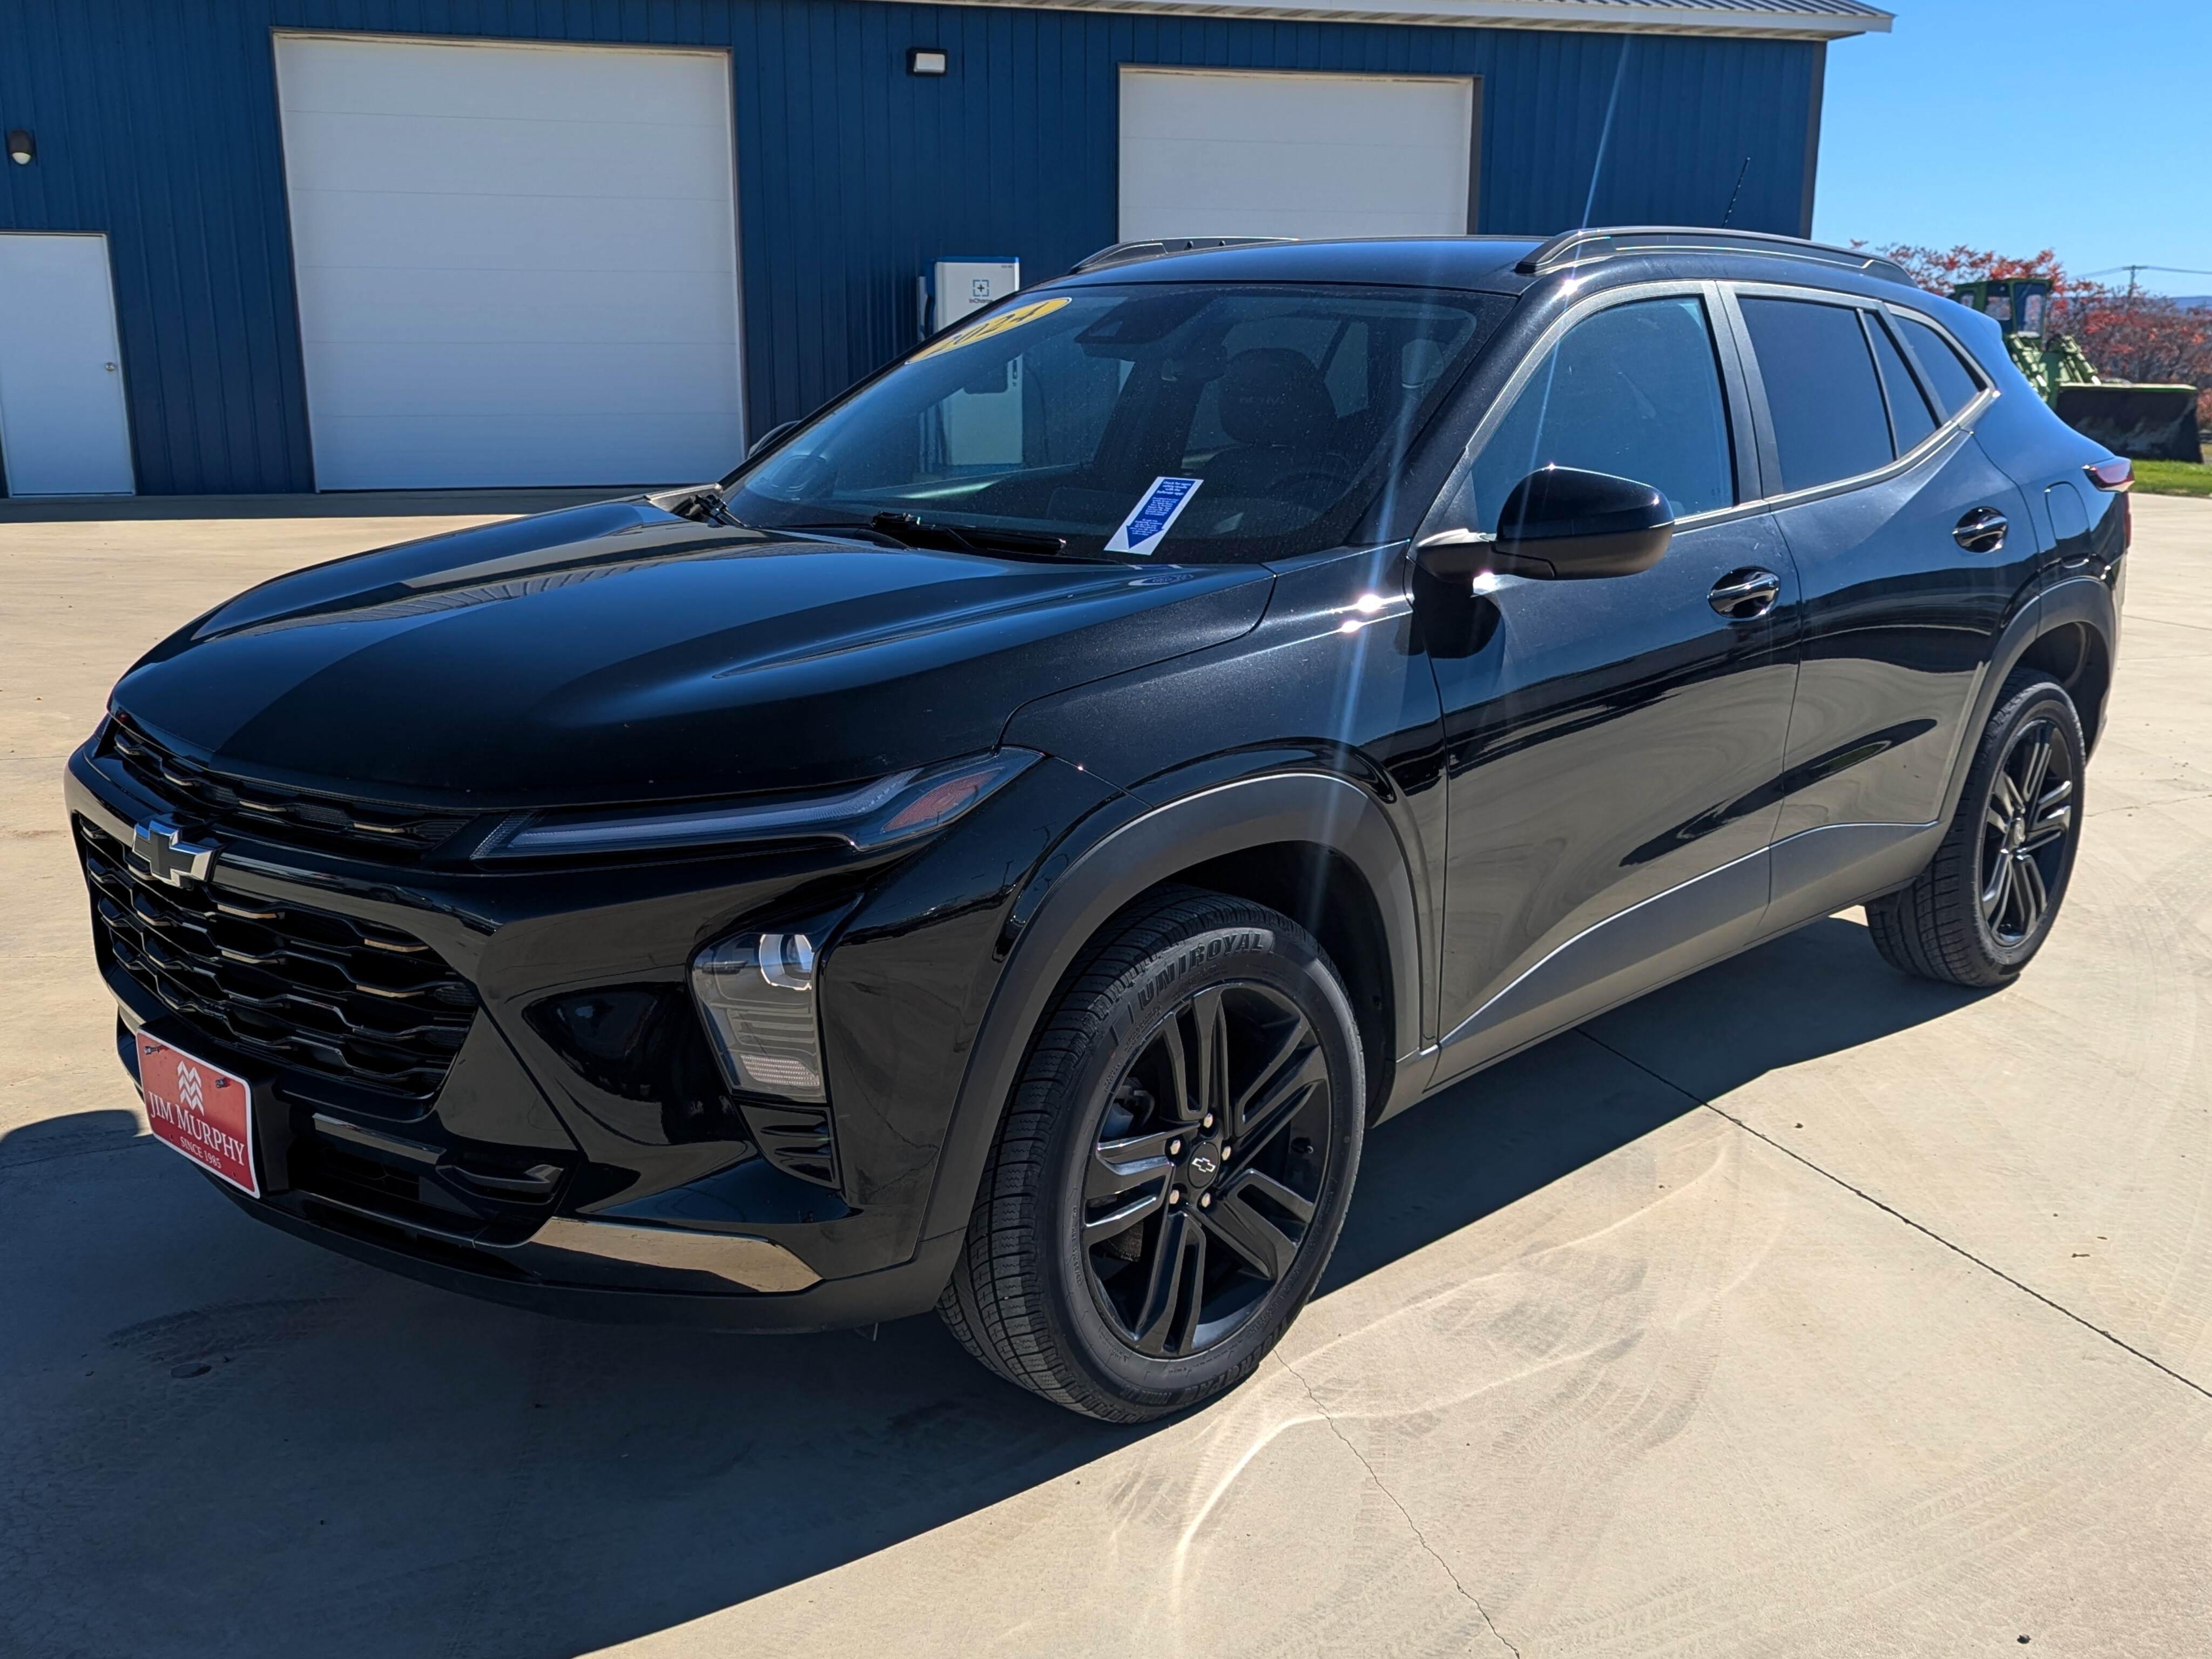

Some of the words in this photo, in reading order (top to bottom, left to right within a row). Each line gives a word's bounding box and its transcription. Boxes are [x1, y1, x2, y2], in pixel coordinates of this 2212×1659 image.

[1137, 932, 1264, 1010] UNIROYAL
[149, 1091, 174, 1125] JIM
[175, 1104, 245, 1165] MURPHY
[180, 1136, 204, 1158] SINCE
[204, 1150, 221, 1169] 1985
